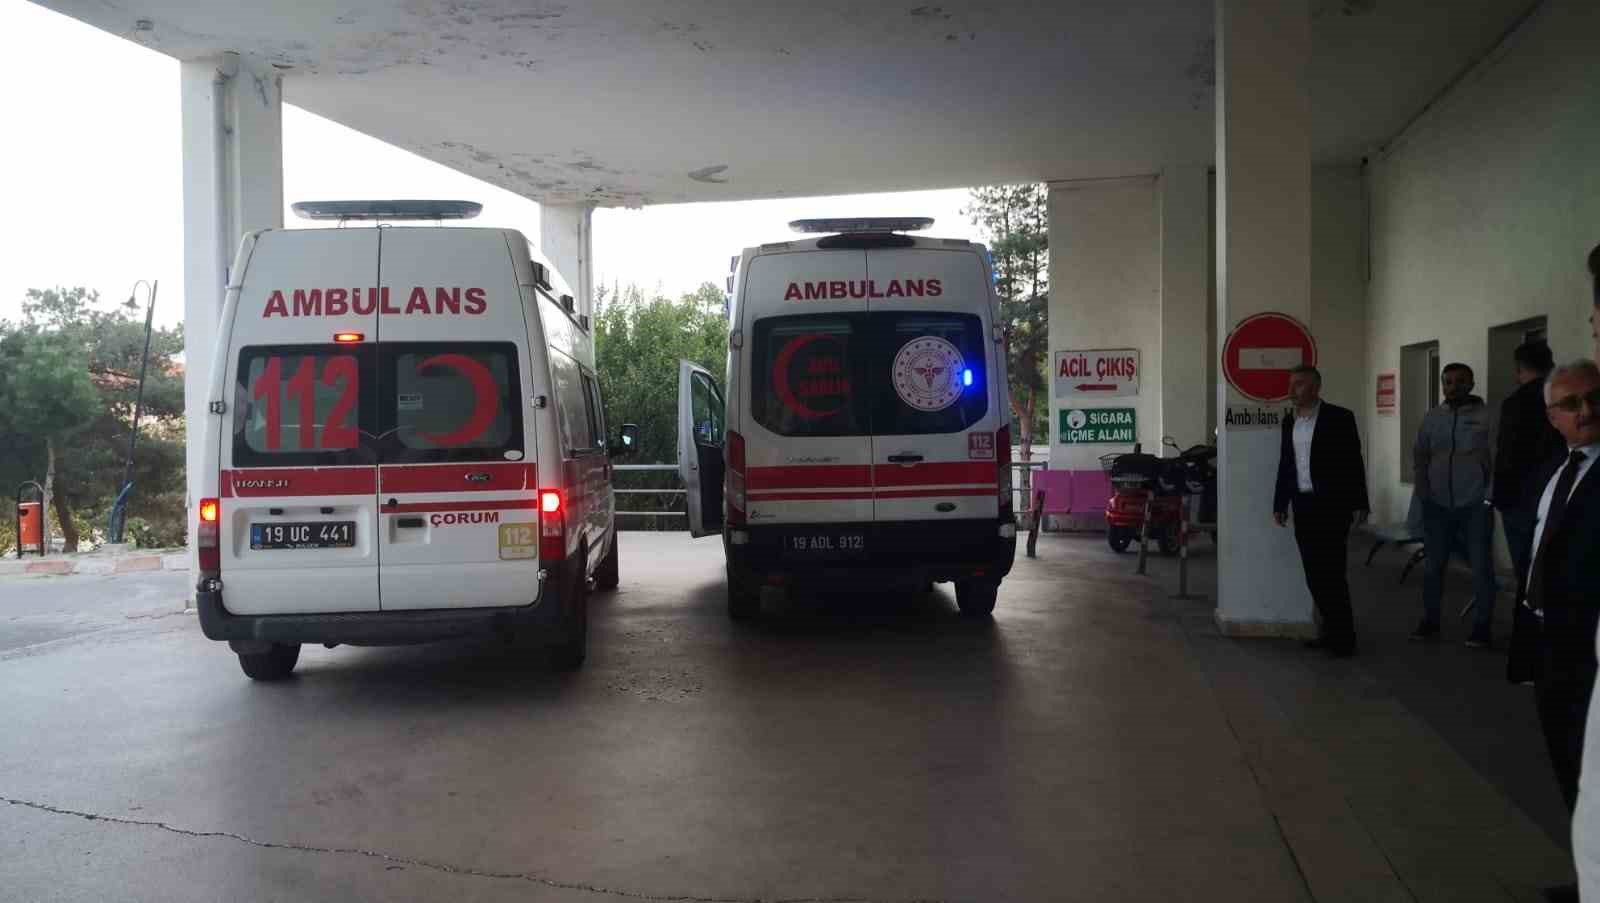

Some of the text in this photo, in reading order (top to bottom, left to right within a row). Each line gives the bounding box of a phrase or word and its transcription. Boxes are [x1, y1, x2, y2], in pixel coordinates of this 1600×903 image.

[784, 279, 943, 300] AMBULANS
[263, 286, 487, 317] AMBULANS
[1060, 354, 1135, 381] ACİL ÇIKIŞ
[254, 354, 360, 450] 112
[972, 436, 991, 450] 112
[1098, 429, 1132, 441] ALANI
[430, 512, 499, 527] ÇORUM
[265, 525, 349, 543] 19 UC 441
[506, 527, 532, 545] 112
[793, 536, 806, 550] 19
